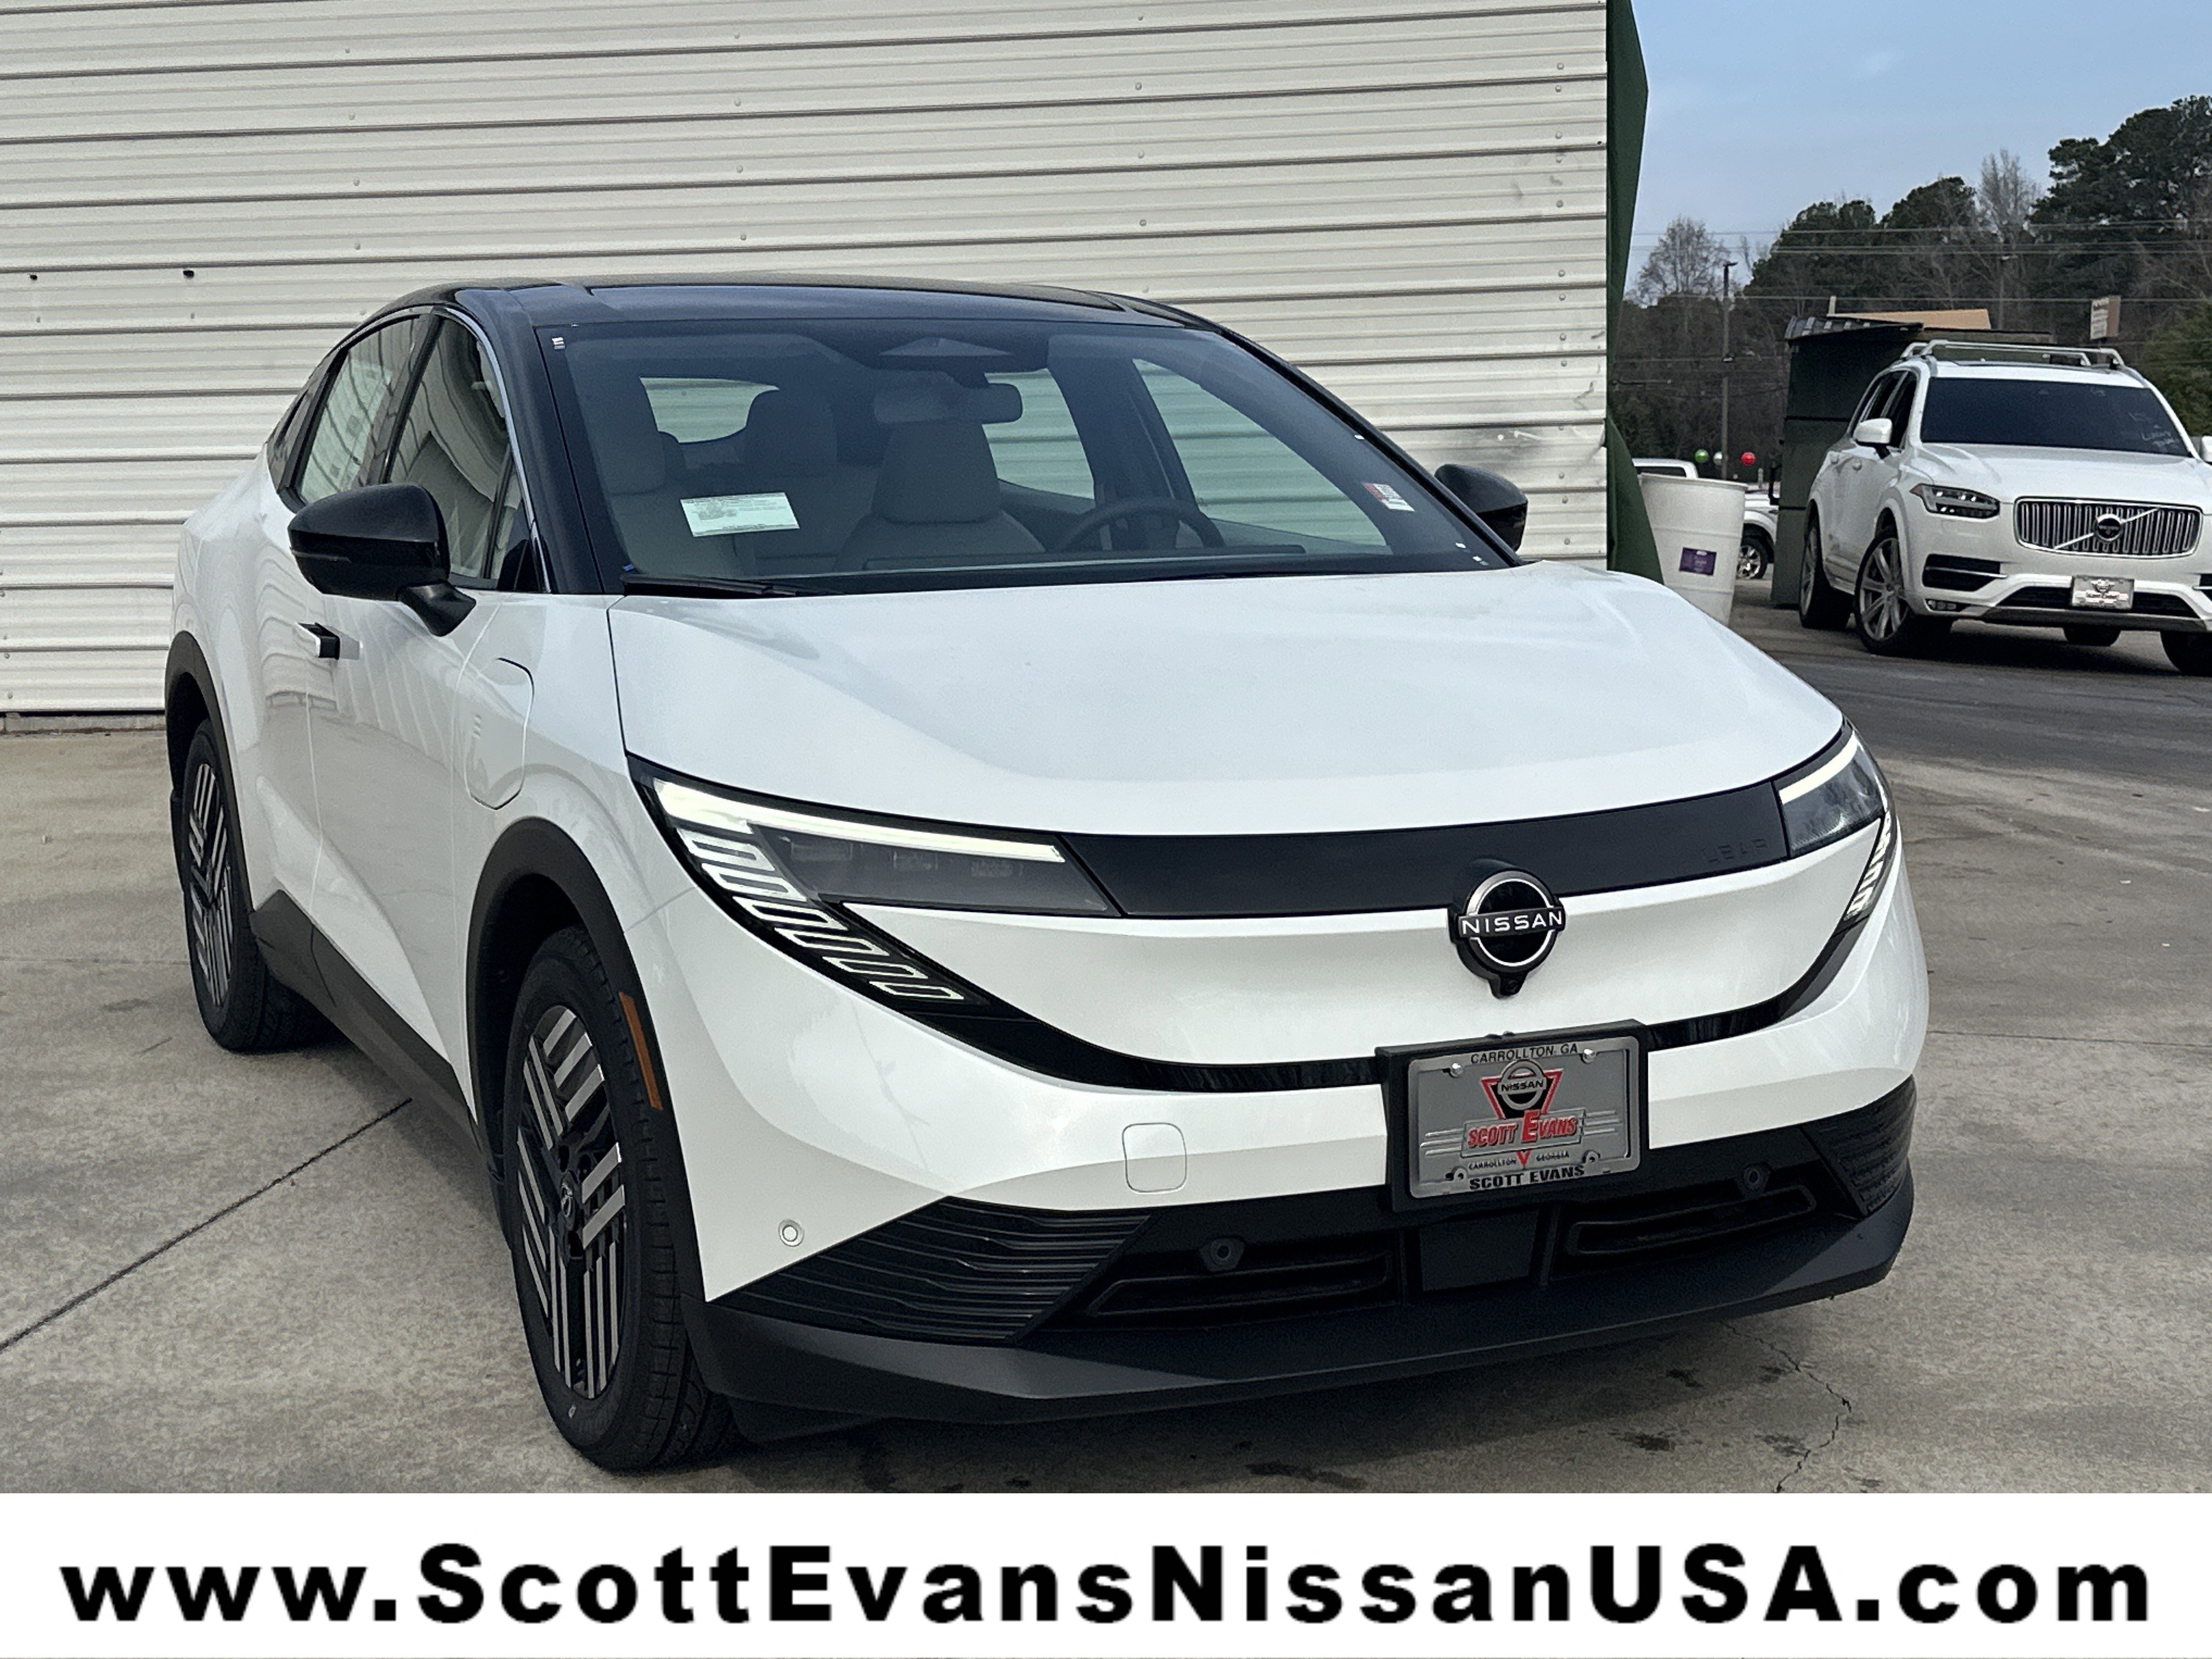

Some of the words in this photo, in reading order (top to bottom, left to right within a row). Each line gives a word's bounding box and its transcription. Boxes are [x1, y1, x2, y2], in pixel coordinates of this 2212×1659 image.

[1462, 910, 1562, 935] NISSAN
[1560, 1043, 1578, 1054] GA
[1501, 1080, 1544, 1091] NISSAN
[1467, 1122, 1518, 1148] SCOTT
[1521, 1109, 1577, 1143] EVANS
[1469, 1172, 1524, 1190] SCOTT
[1530, 1165, 1585, 1183] EVANS
